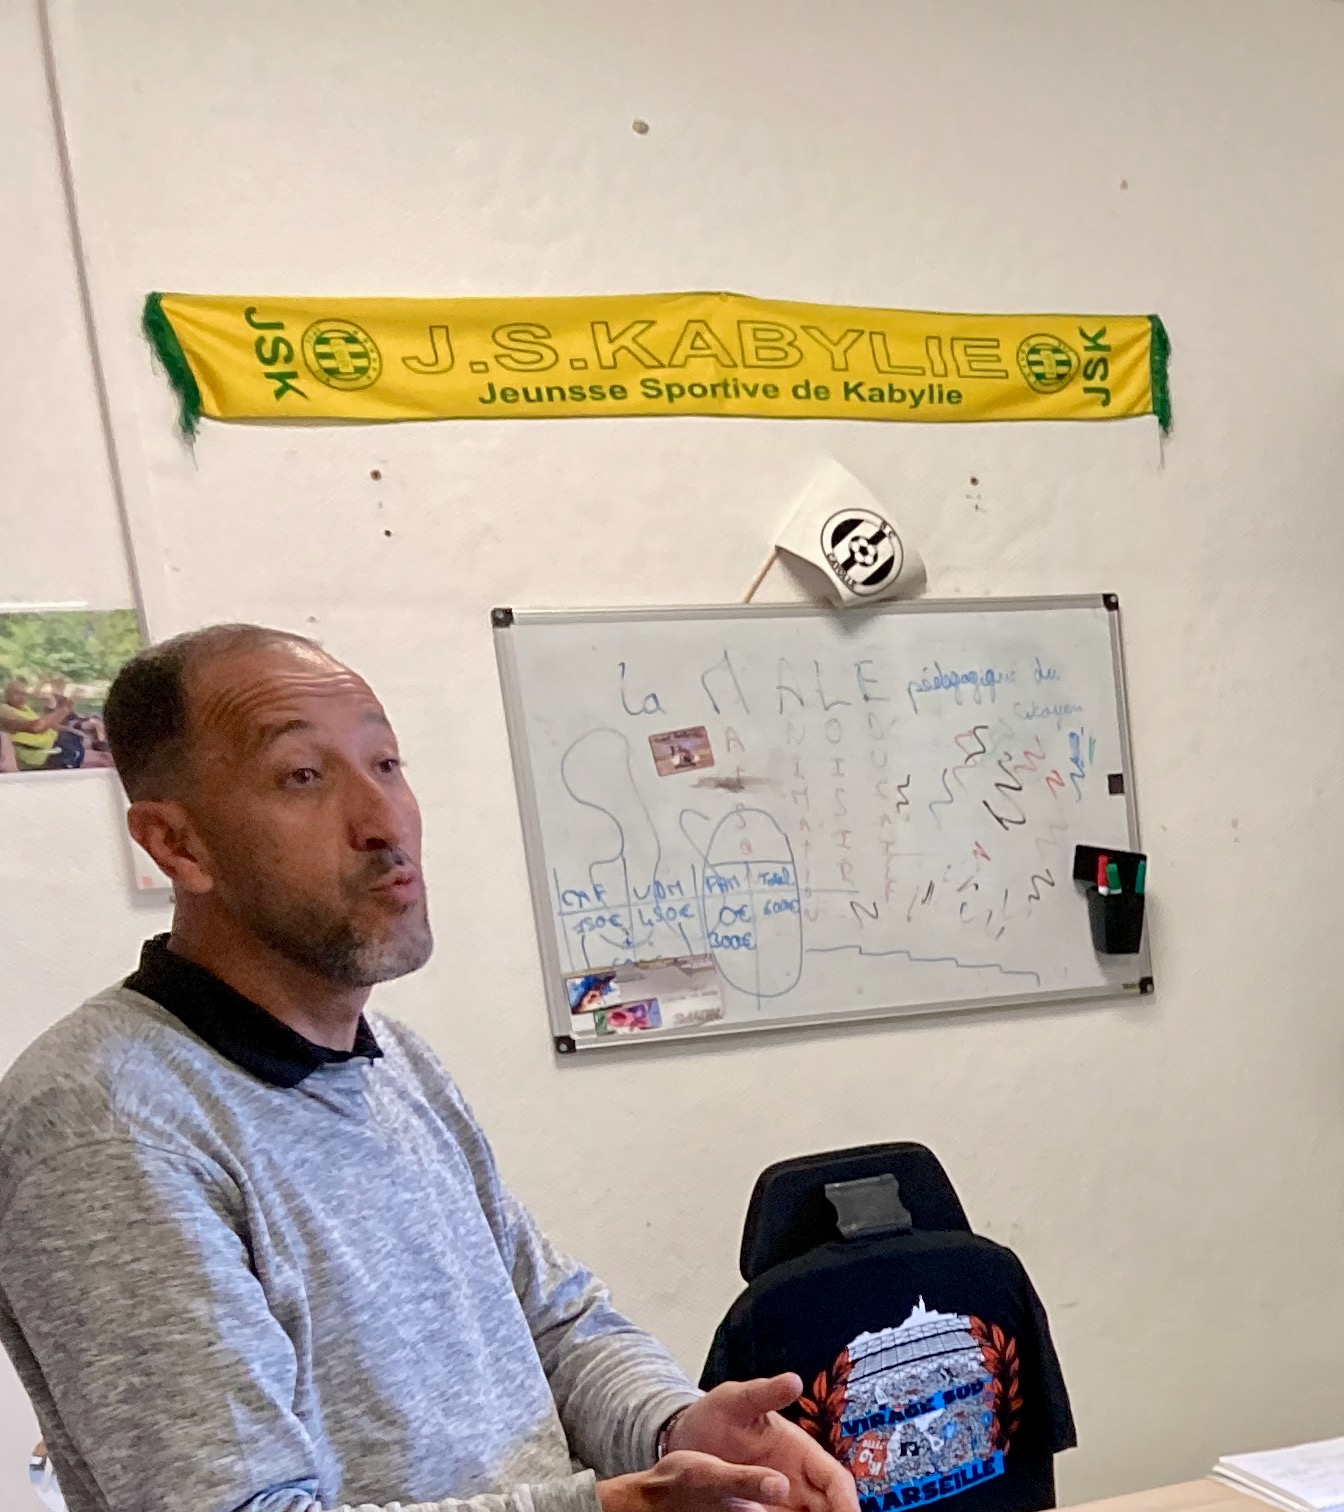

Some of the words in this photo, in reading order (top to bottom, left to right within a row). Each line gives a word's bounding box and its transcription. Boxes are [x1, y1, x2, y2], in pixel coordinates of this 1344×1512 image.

[244, 306, 310, 401] JSK
[401, 319, 1009, 379] J.S.KABYLIE
[1079, 325, 1111, 408] JSK
[479, 381, 628, 404] Jeunsse
[640, 377, 780, 403] Sportive
[792, 380, 831, 401] de
[843, 382, 963, 409] Kabylie
[842, 1397, 937, 1436] VIRAGE
[943, 1379, 985, 1405] SUD
